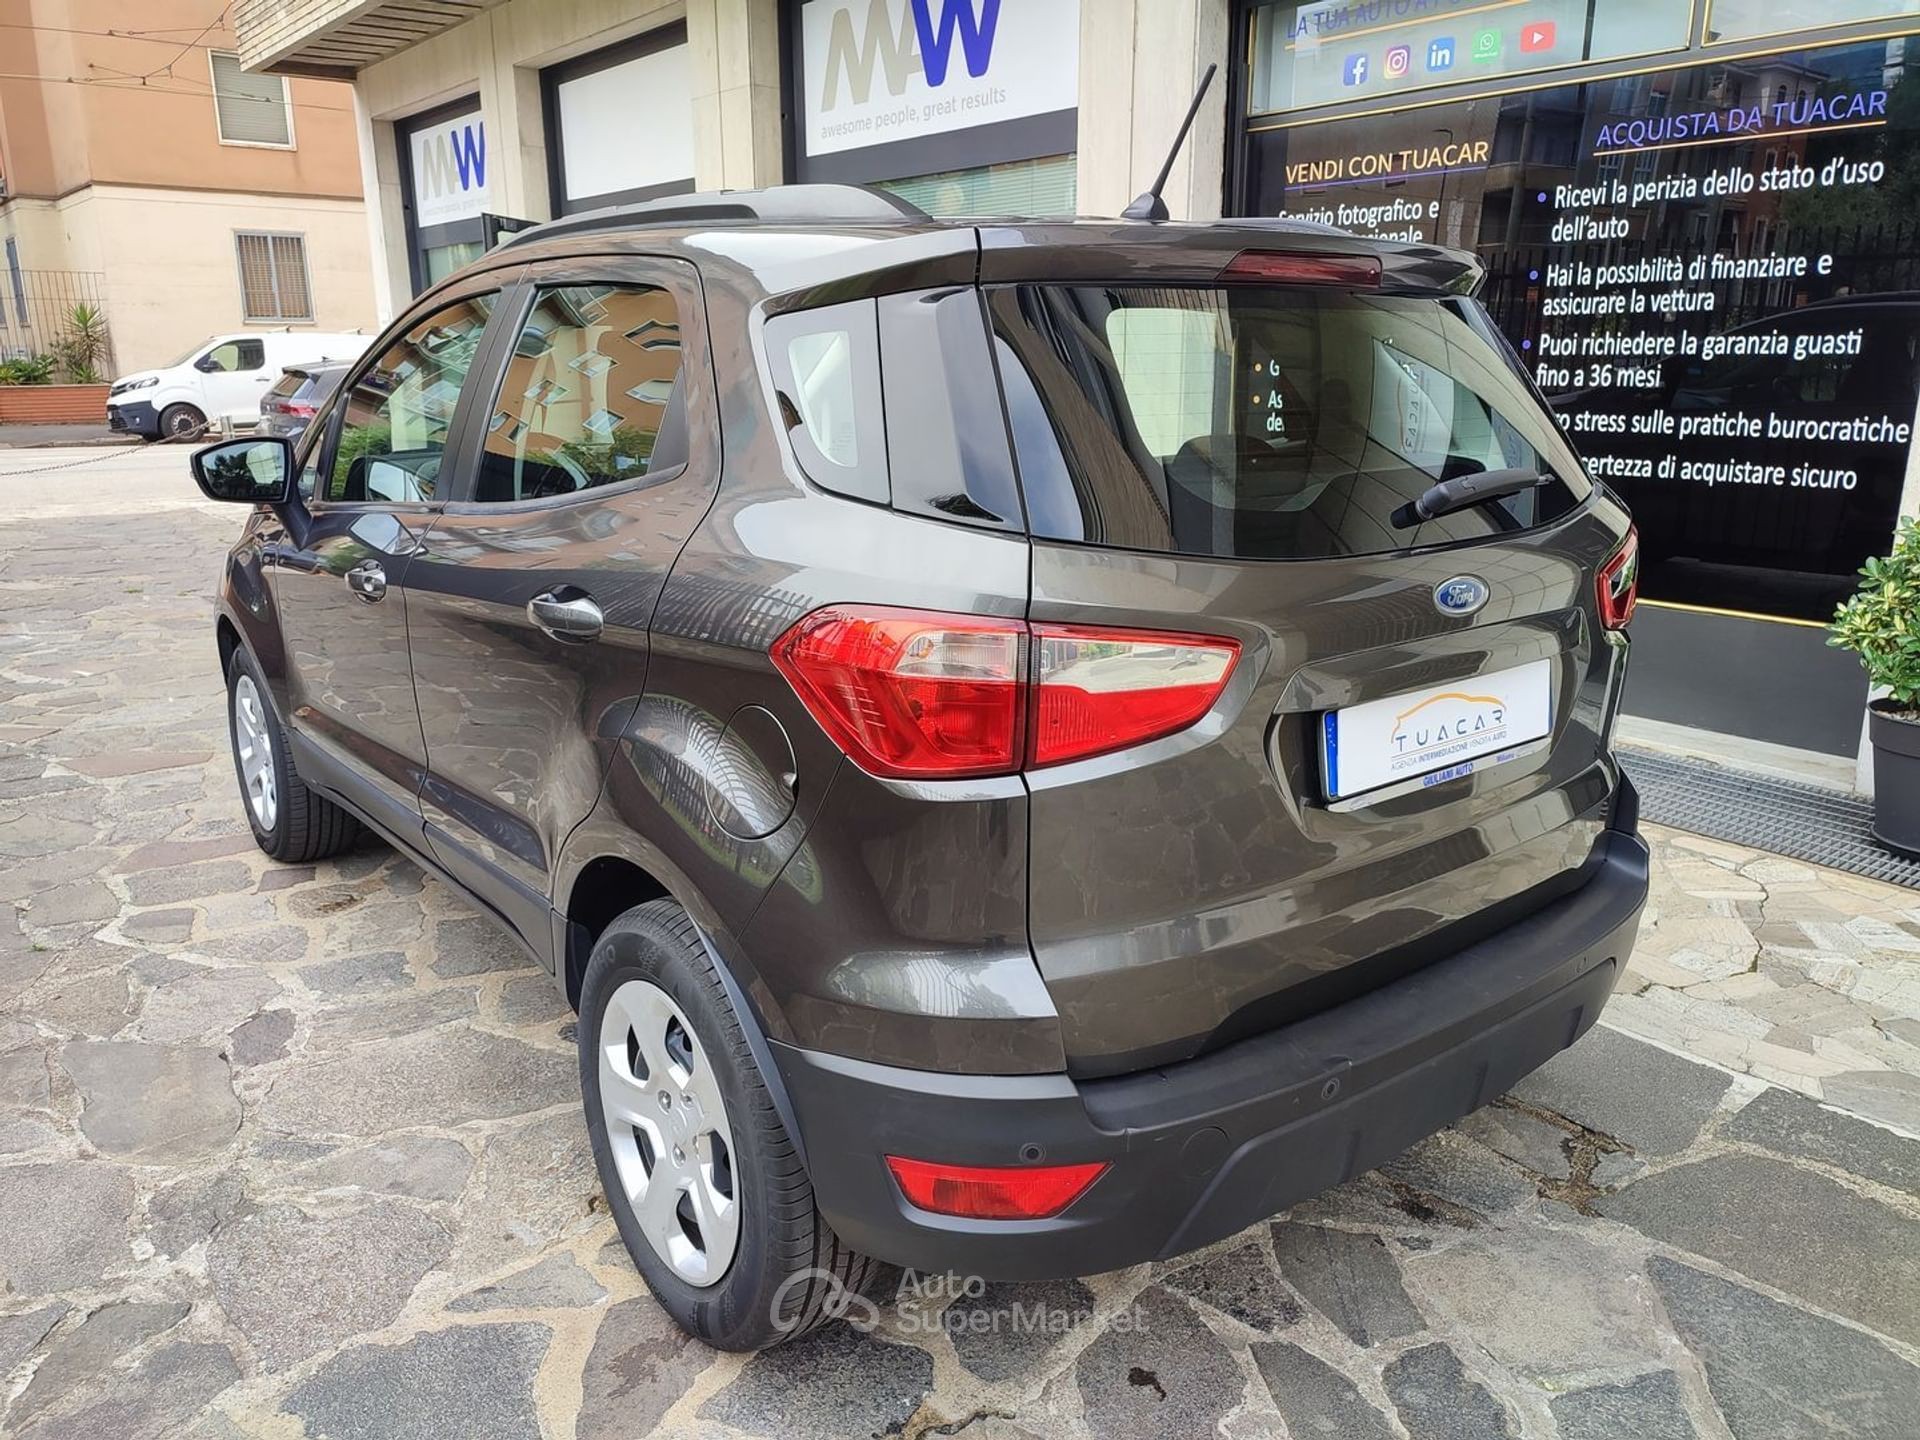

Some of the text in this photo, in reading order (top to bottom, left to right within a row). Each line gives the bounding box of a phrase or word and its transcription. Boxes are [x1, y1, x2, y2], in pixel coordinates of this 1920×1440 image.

[821, 87, 1006, 139] awesome people, great results
[1596, 91, 1888, 147] ACQUISTA DA TUACAR
[1285, 141, 1489, 184] VENDI CON TUACAR
[1554, 156, 1884, 210] Ricevi la perizia dello stato d'uso
[1338, 198, 1422, 228] fotografico
[1429, 201, 1439, 218] e
[1551, 216, 1629, 244] dell'auto
[1546, 261, 1573, 288] Hai
[1577, 262, 1591, 286] la
[1688, 255, 1706, 280] di
[1711, 253, 1806, 279] finanziare
[1817, 254, 1833, 275] e
[1542, 289, 1714, 316] assicurare la vettura
[1538, 328, 1863, 360] Puoi richiedere la garanzia guasti
[1536, 363, 1662, 388] fino a 36 mesi
[1266, 411, 1285, 432] de
[1574, 410, 1626, 433] stress
[1631, 409, 1674, 434] sulle
[1679, 411, 1761, 440] pratiche
[1768, 412, 1909, 443] burocratiche
[1657, 455, 1676, 479] di
[1680, 458, 1785, 487] acquistare
[1790, 465, 1857, 490] sicuro
[1395, 709, 1503, 752] TUACAR
[1455, 762, 1474, 777] AUTO
